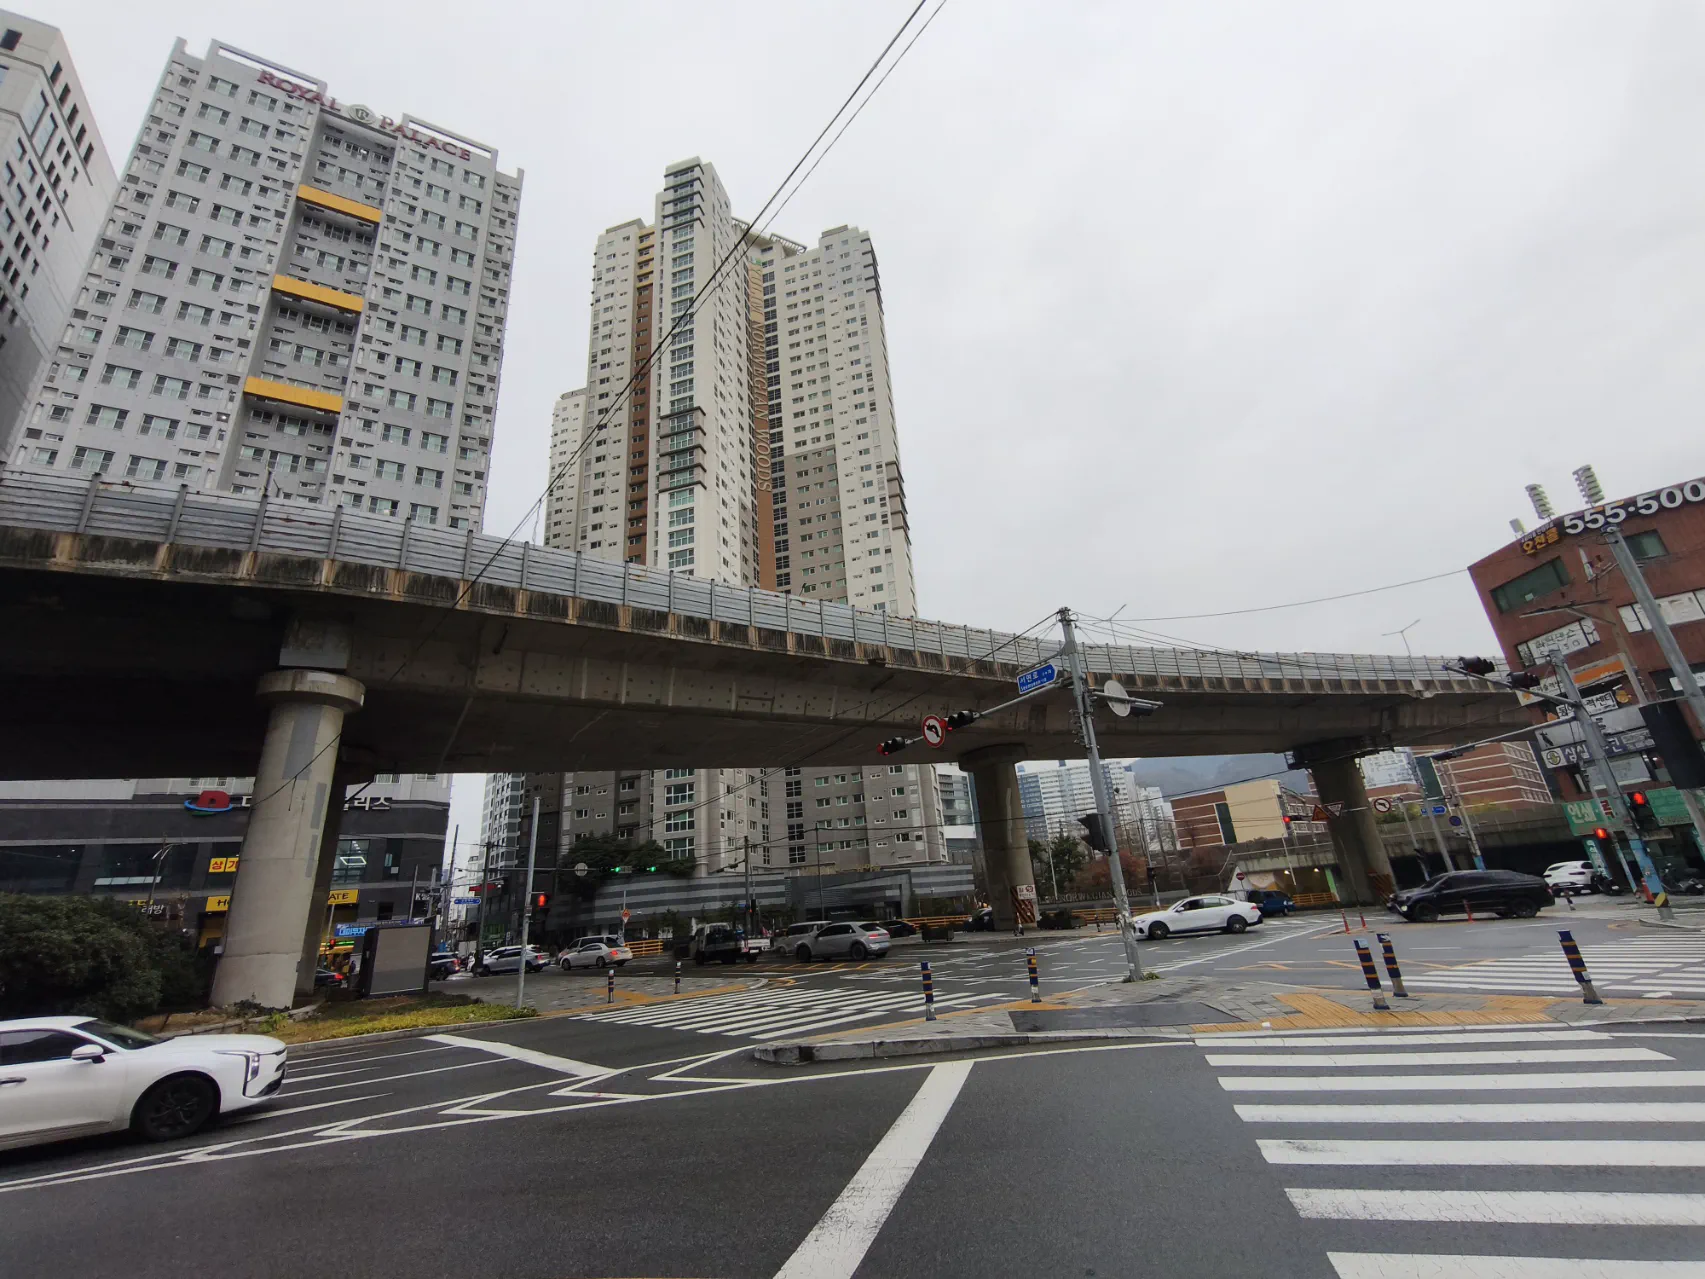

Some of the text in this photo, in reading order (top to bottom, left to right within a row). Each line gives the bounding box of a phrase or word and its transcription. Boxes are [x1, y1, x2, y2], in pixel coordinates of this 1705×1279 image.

[257, 69, 341, 112] ROYAL
[380, 115, 471, 161] PALACE
[1058, 890, 1113, 903] NORWEGIAN
